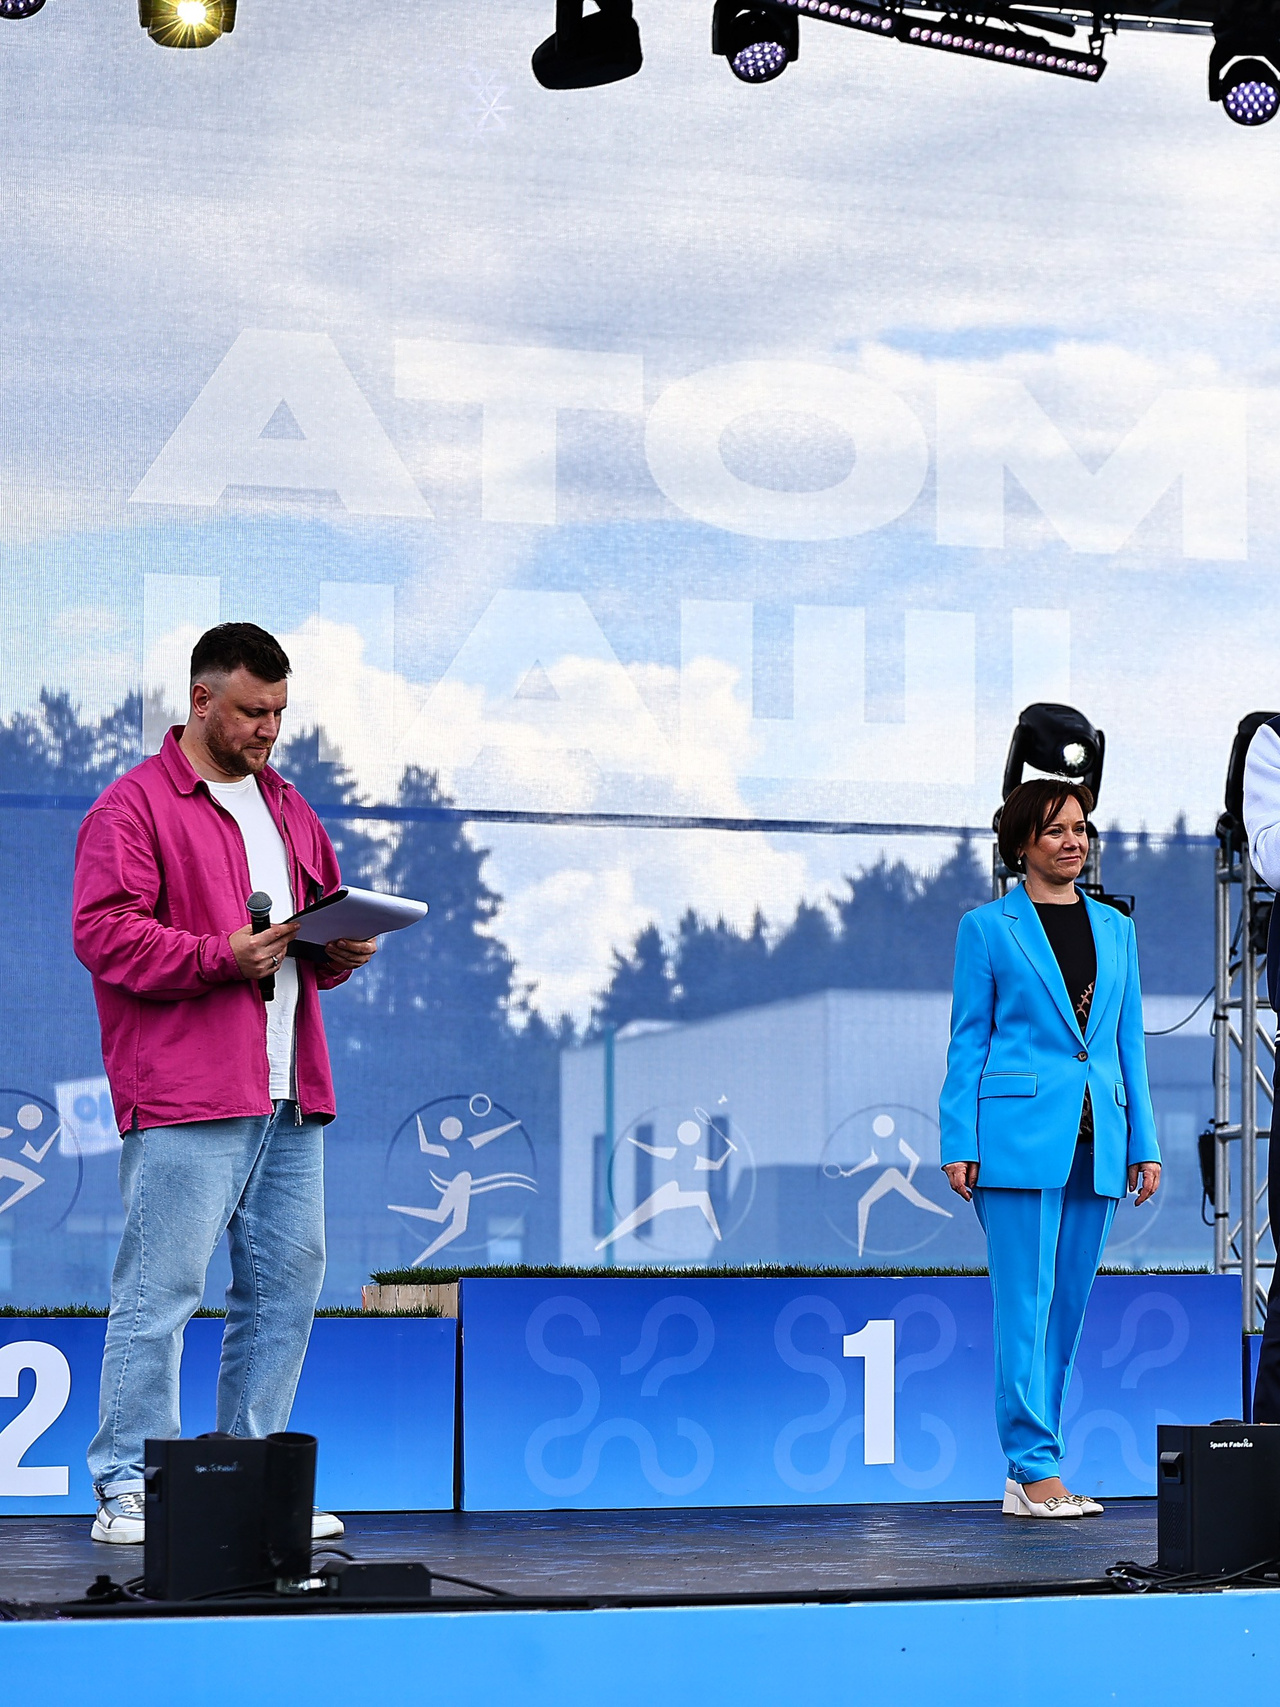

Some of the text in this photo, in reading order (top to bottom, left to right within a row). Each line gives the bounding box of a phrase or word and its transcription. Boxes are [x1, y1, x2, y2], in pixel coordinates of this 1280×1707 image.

[129, 328, 1248, 561] АТОМ
[0, 1340, 71, 1497] 2
[843, 1320, 895, 1465] 1
